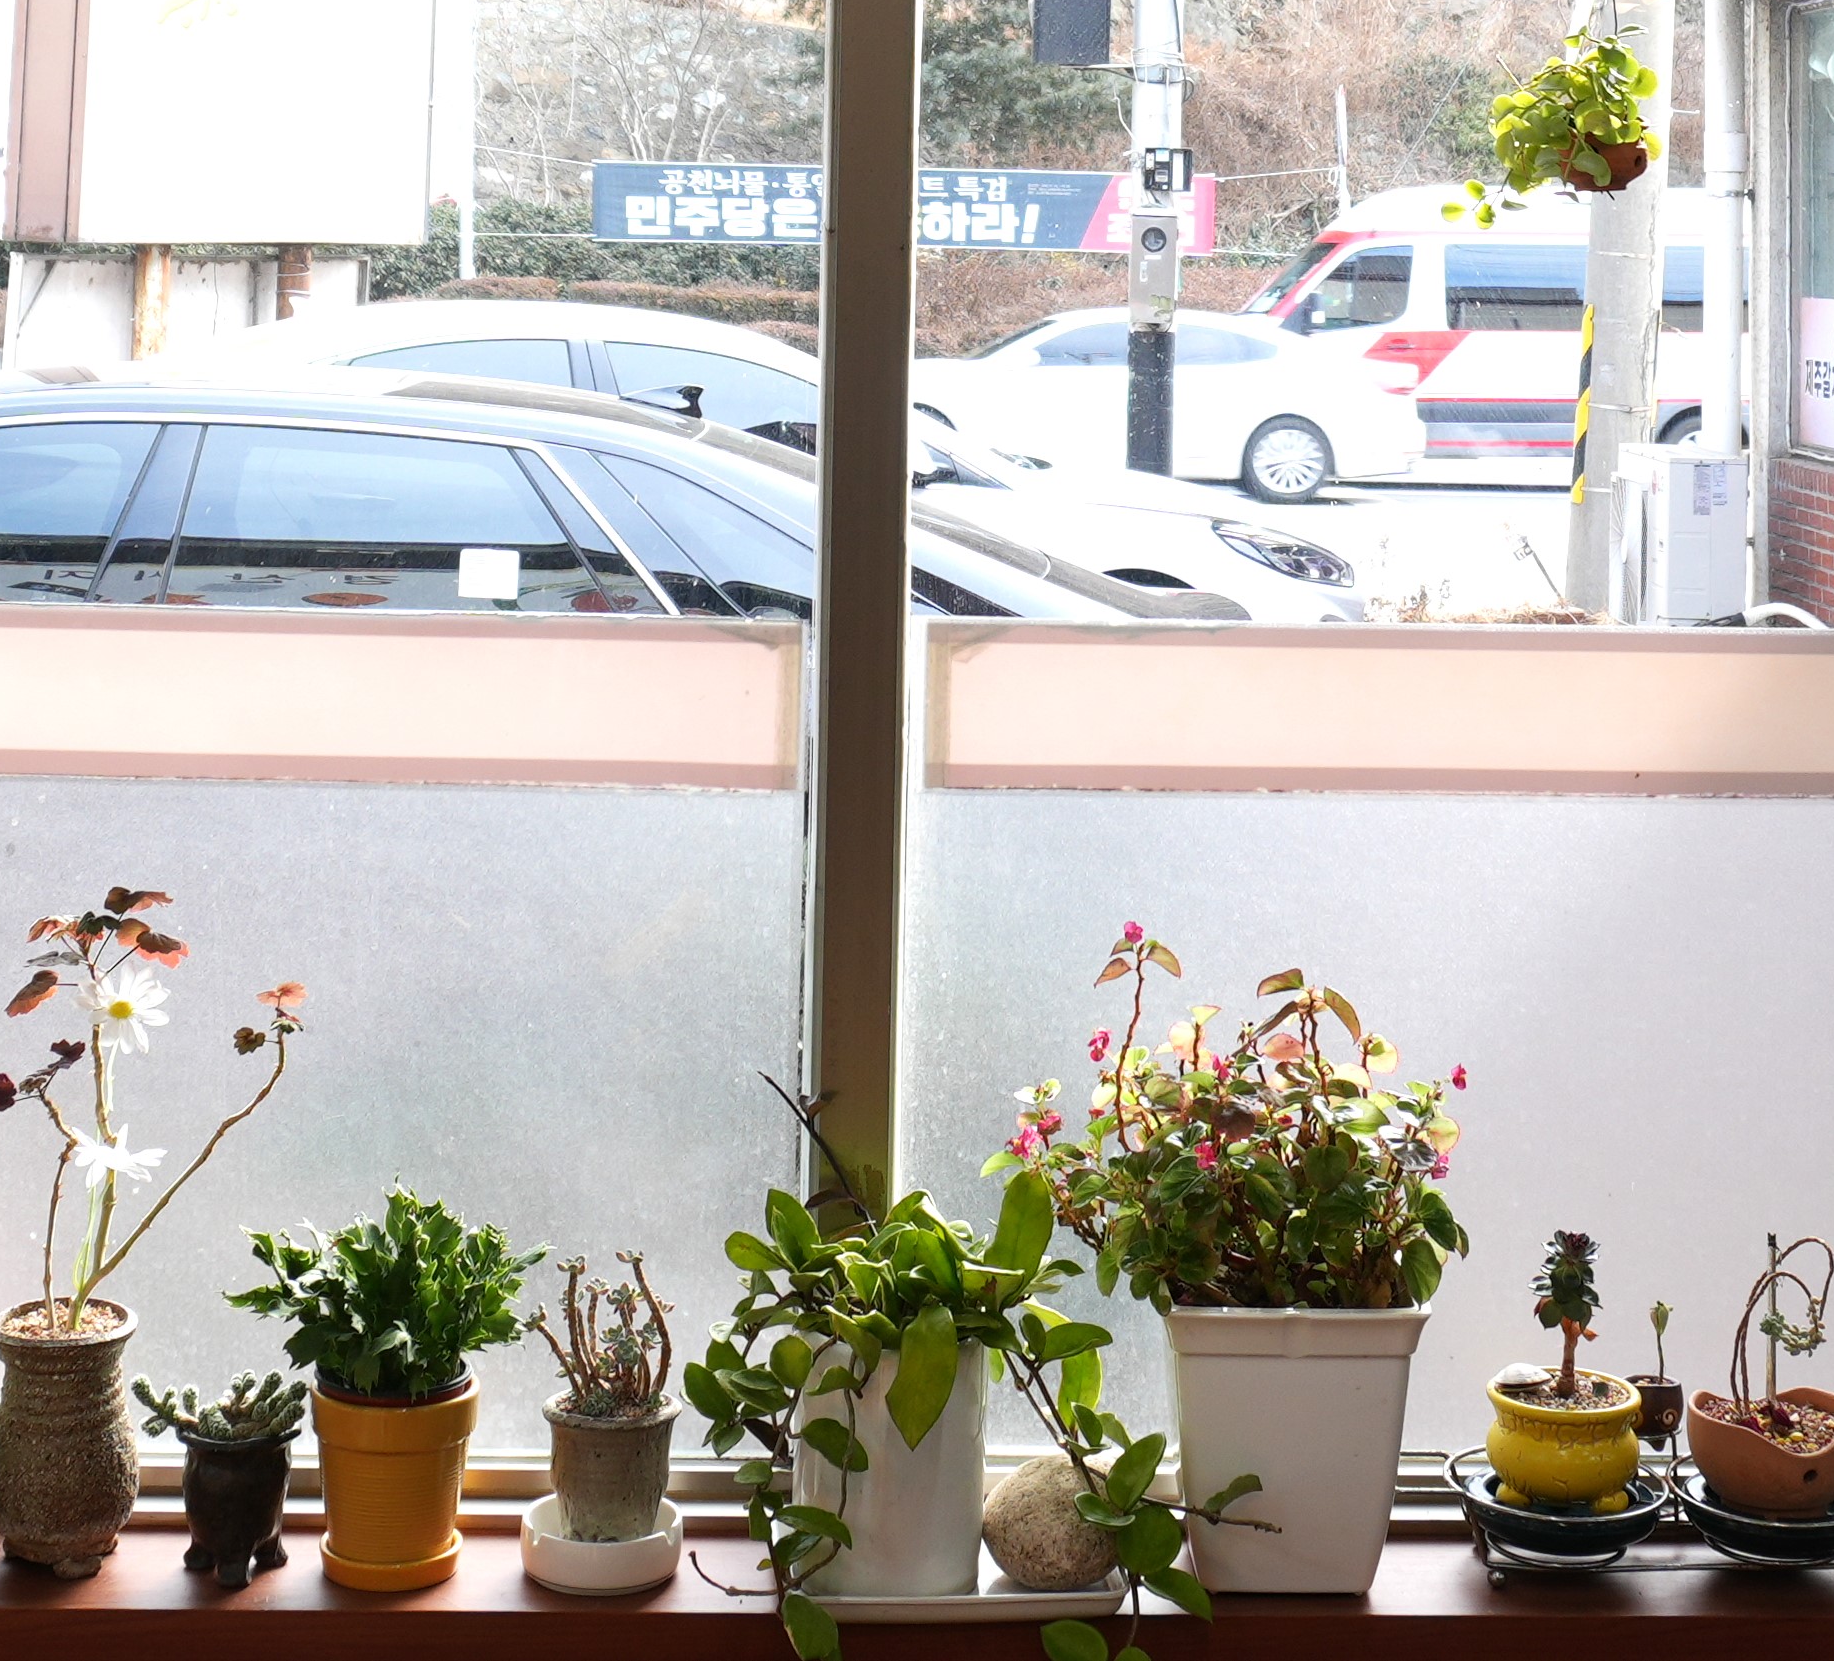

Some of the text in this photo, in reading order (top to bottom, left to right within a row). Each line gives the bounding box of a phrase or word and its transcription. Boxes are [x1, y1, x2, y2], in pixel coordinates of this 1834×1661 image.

[953, 175, 1008, 203] 특검
[624, 194, 1041, 243] 민주당은 하라!
